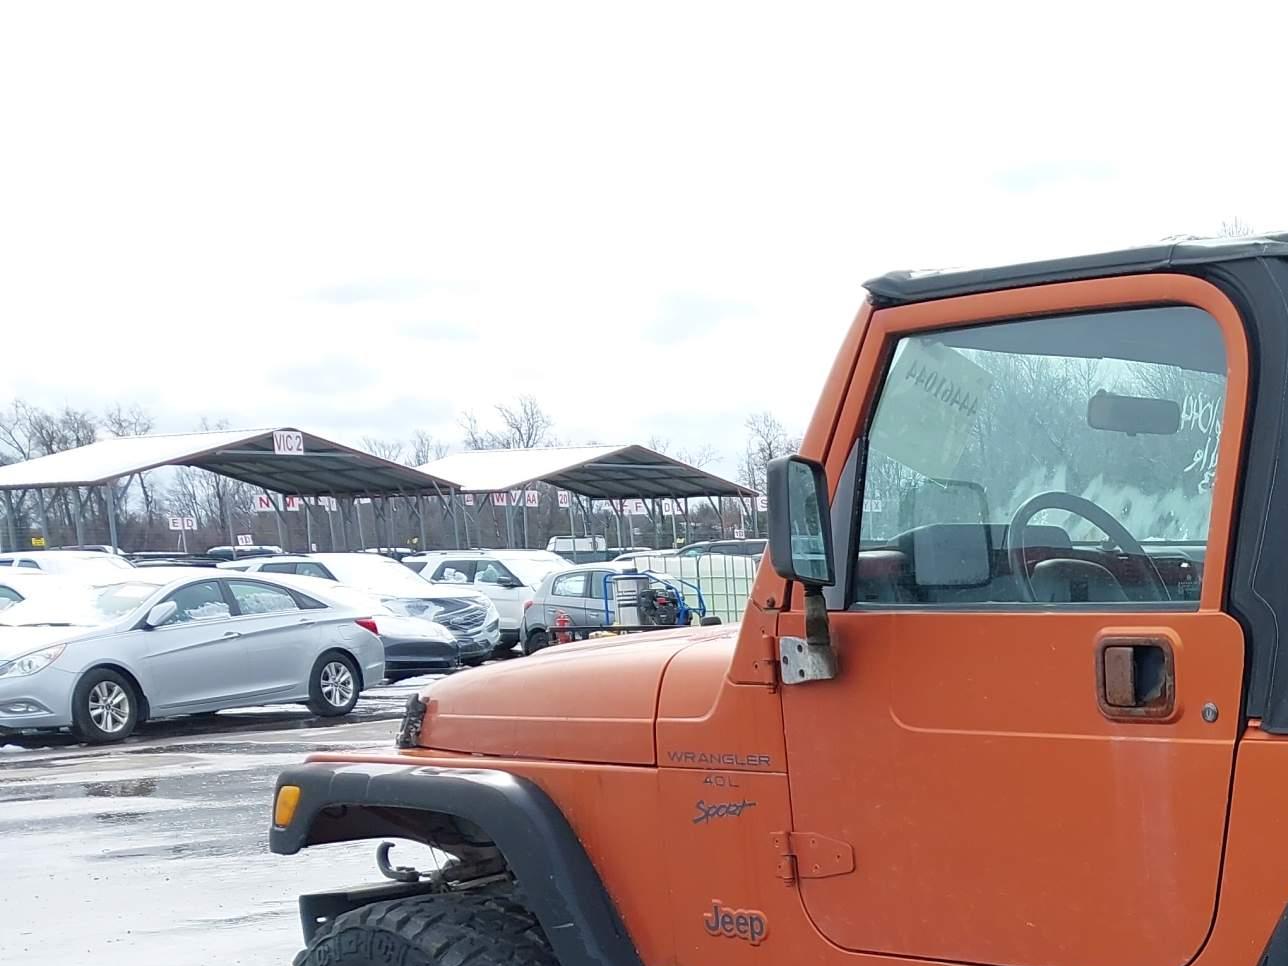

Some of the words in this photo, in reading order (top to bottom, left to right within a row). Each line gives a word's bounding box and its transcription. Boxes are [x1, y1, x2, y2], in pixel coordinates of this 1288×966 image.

[274, 434, 293, 451] VIC
[295, 435, 302, 451] 2
[259, 496, 270, 508] N
[495, 493, 505, 503] W
[526, 494, 537, 504] AA
[559, 494, 568, 504] 20
[172, 519, 178, 528] E
[186, 519, 193, 528] D
[667, 752, 770, 766] WRANGLER
[692, 799, 757, 825] Sport
[704, 902, 767, 942] Jeep
